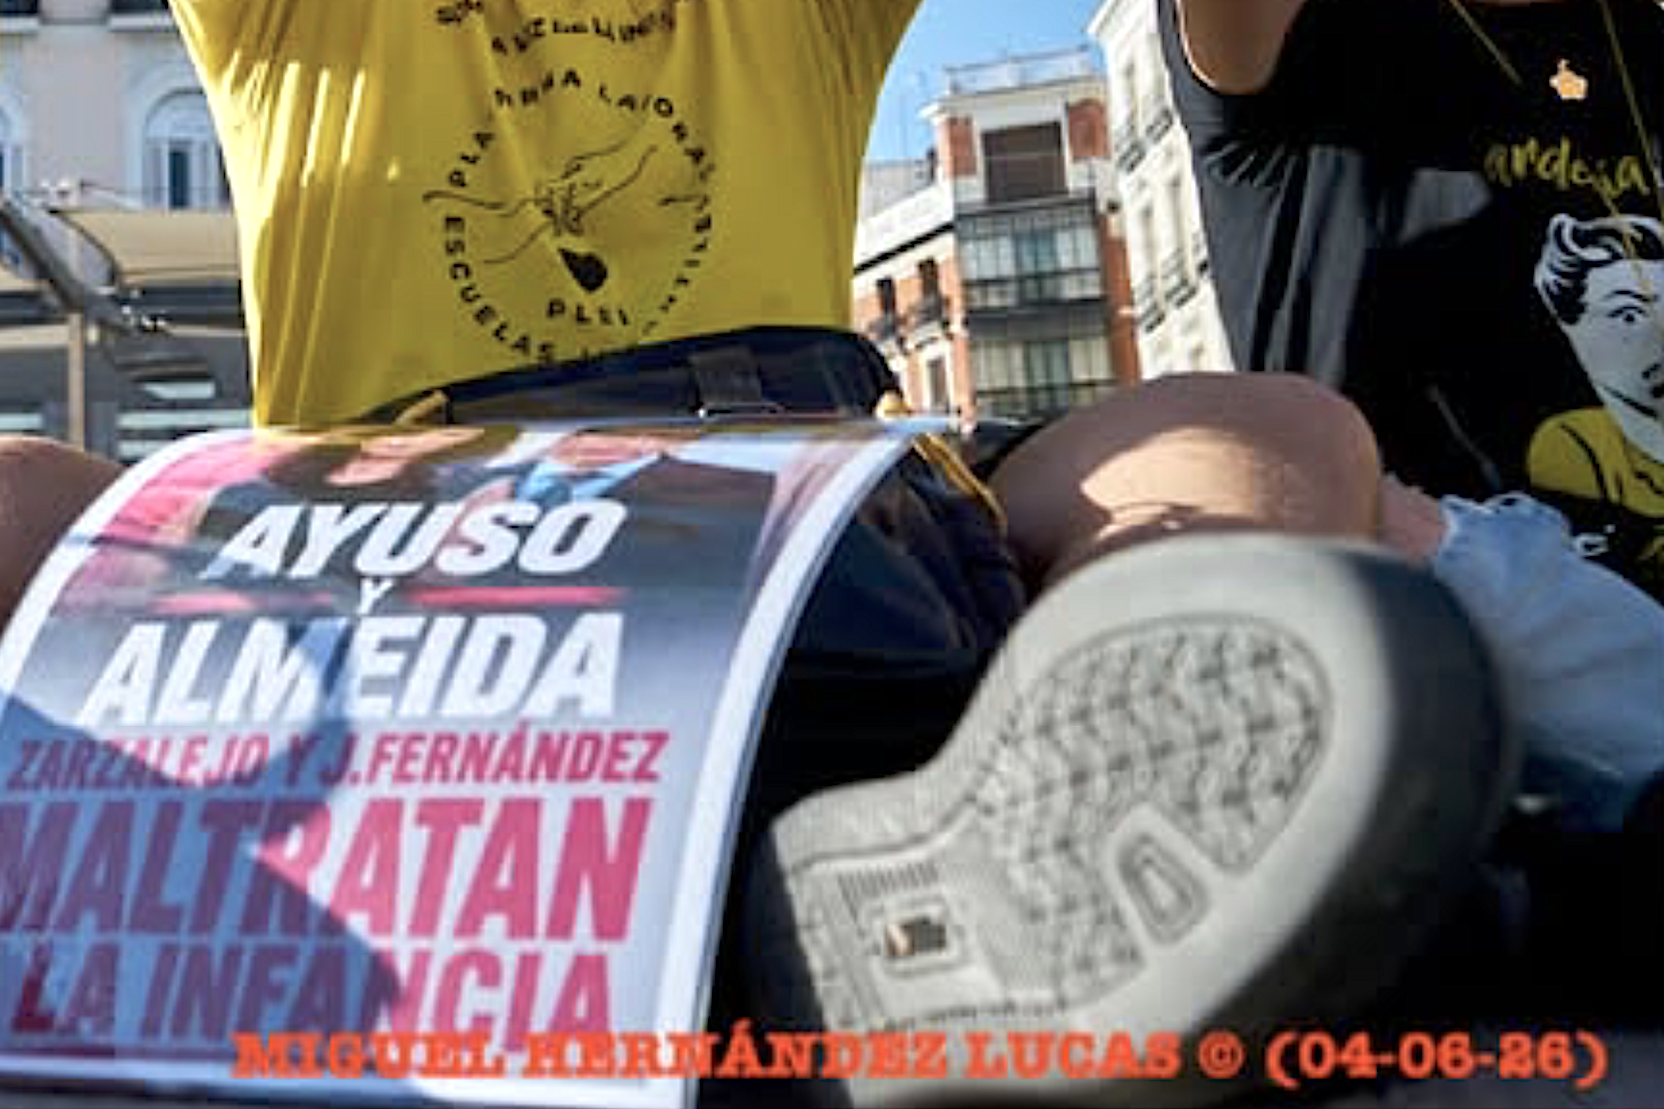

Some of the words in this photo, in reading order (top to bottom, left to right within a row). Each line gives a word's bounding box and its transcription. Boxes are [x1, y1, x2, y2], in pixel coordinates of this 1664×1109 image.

[199, 499, 627, 580] AYUSO
[356, 578, 394, 615] Y
[72, 613, 626, 727] ALMEIDA
[6, 732, 271, 790] ZARZALEJO
[284, 732, 324, 786] Y
[320, 720, 671, 788] J.FERNÁNDEZ
[11, 940, 121, 1033] LA
[140, 941, 613, 1053] INFANCIA
